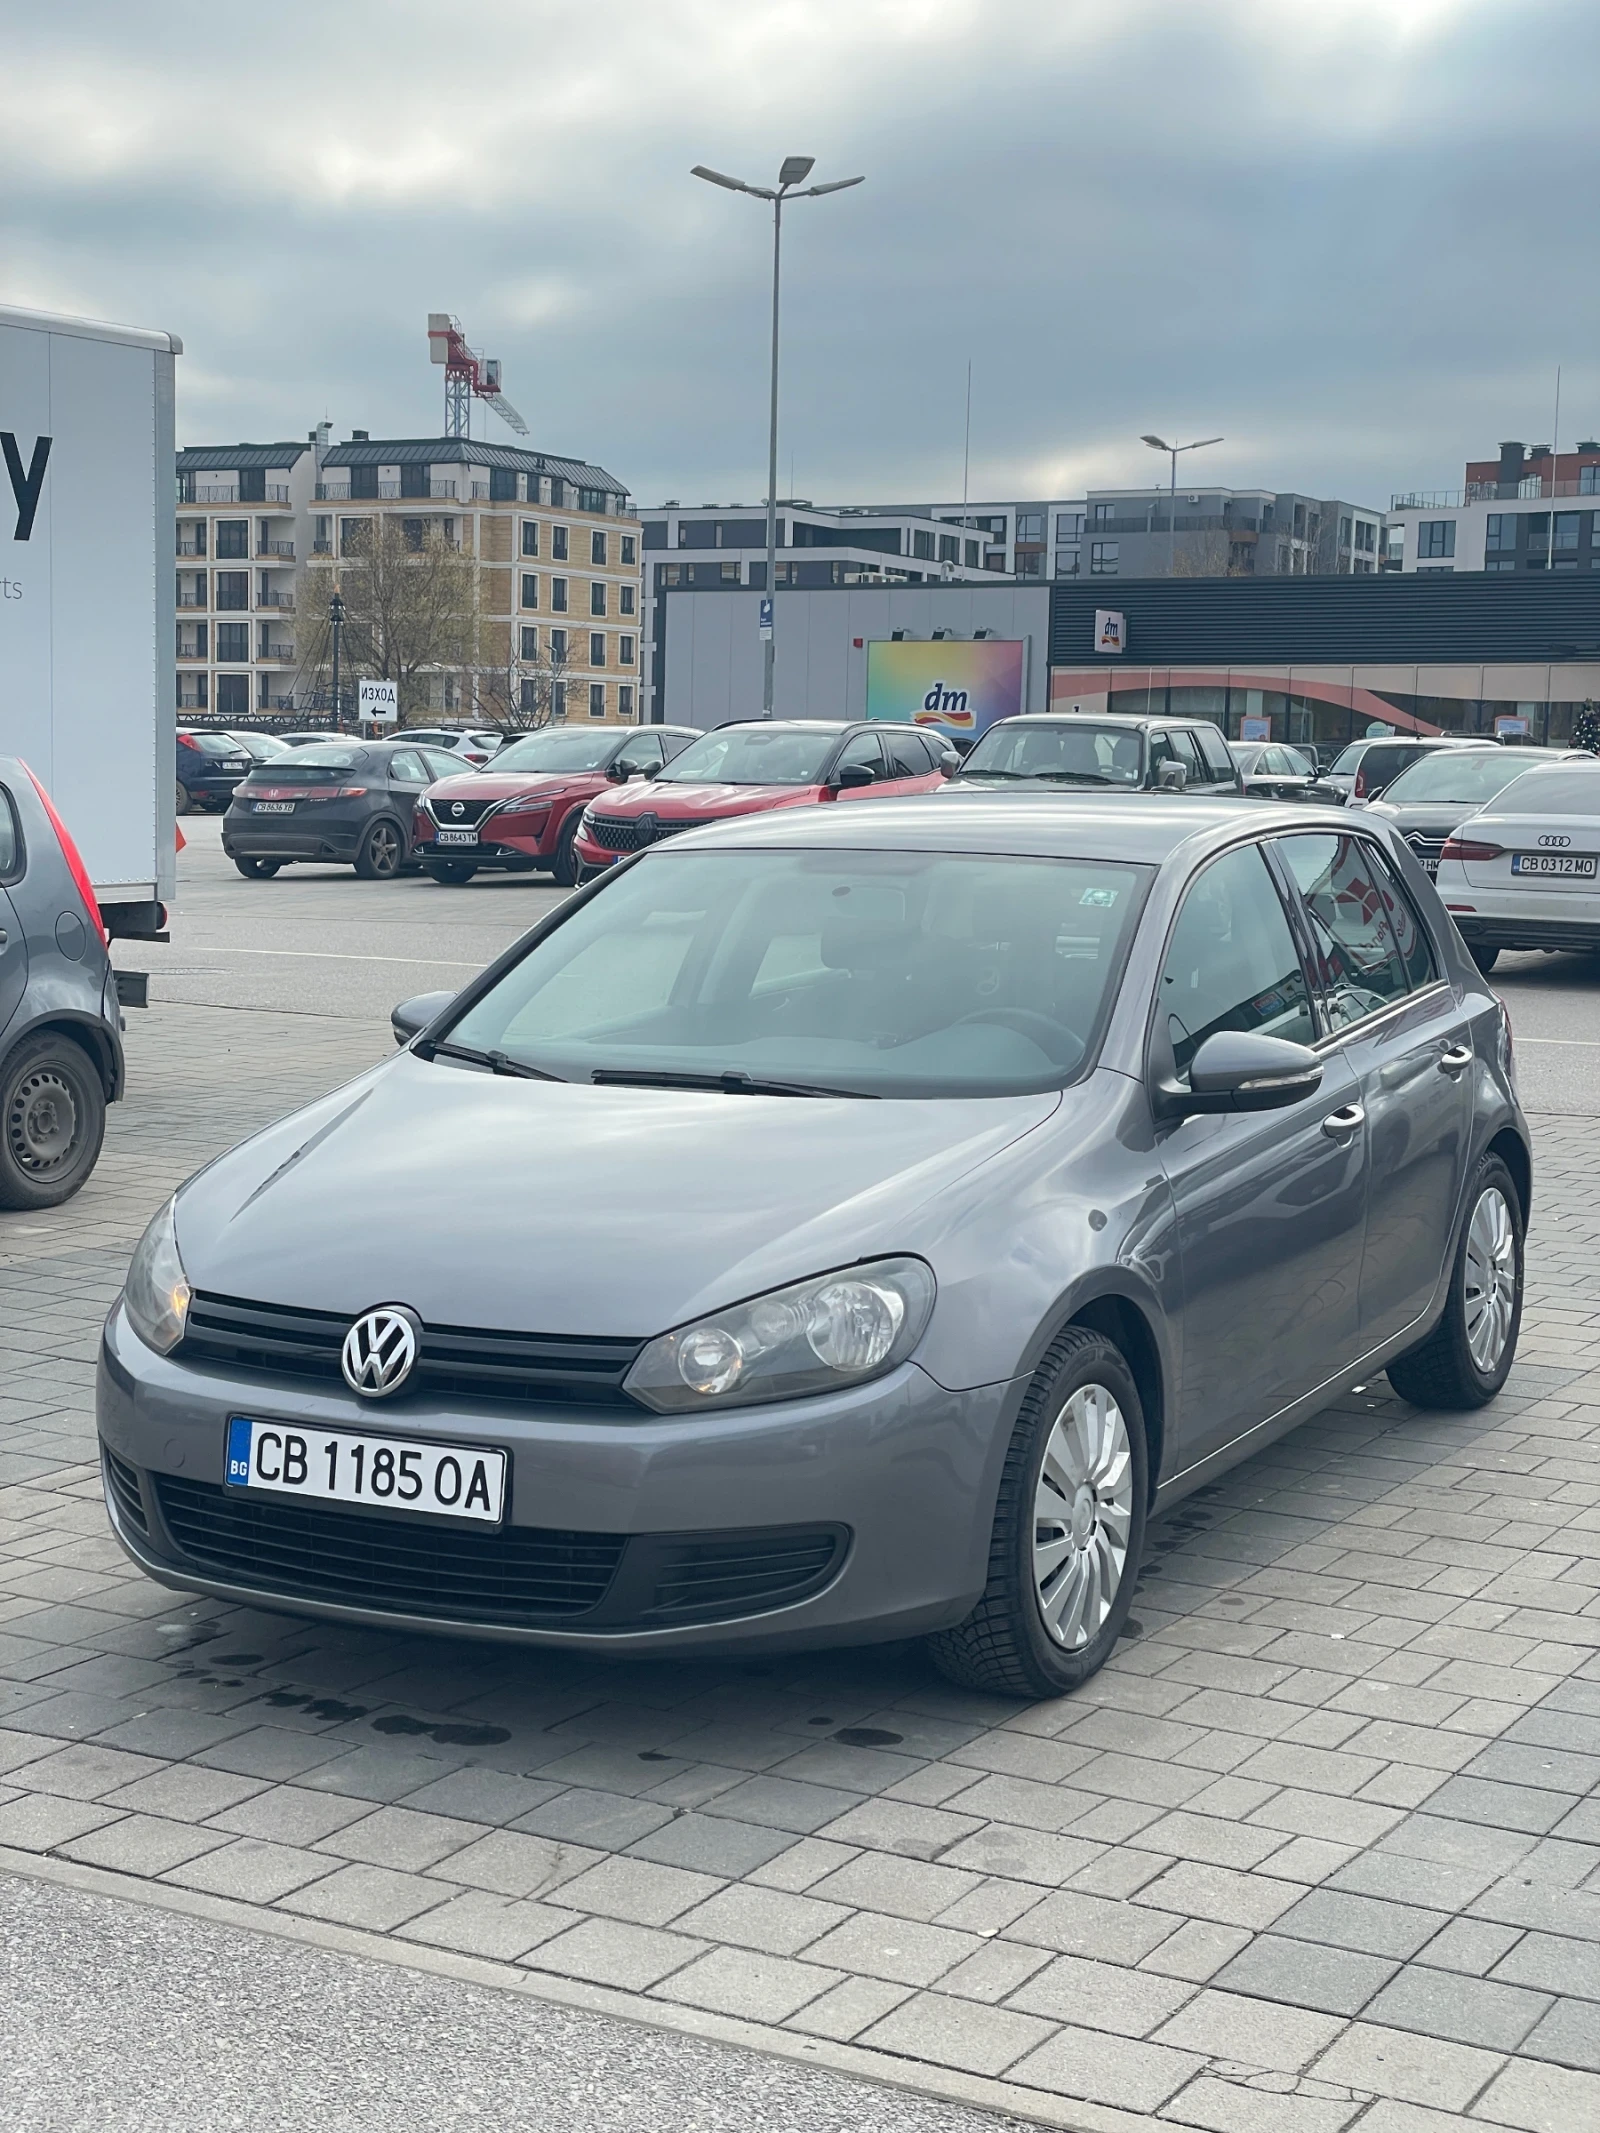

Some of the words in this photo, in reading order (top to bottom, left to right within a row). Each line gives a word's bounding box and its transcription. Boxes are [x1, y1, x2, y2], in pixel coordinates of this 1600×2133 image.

[0, 577, 22, 600] ts
[1104, 617, 1119, 636] dm
[361, 687, 396, 704] ИЗХОД
[924, 683, 967, 711] dm
[440, 832, 449, 842] CB
[450, 833, 467, 843] 8643
[1521, 857, 1539, 871] CB
[1541, 858, 1573, 872] 0312
[1574, 859, 1593, 873] MO
[230, 1459, 248, 1476] BG
[256, 1432, 307, 1485] CB
[324, 1440, 423, 1501] 1185
[434, 1455, 492, 1512] OA
